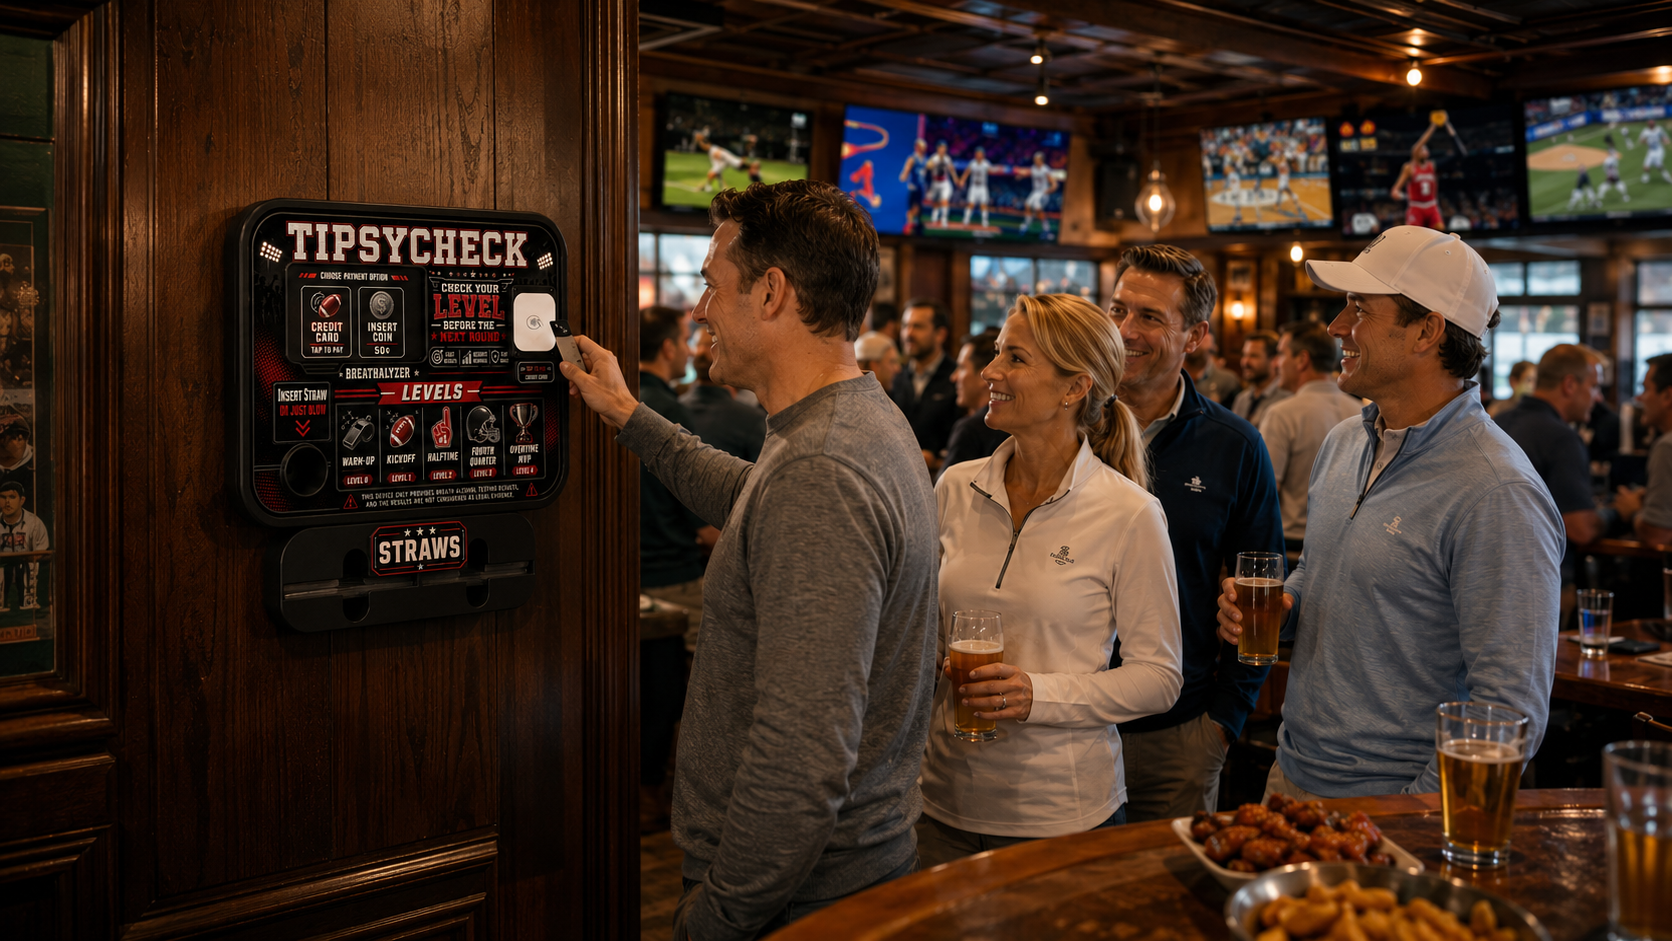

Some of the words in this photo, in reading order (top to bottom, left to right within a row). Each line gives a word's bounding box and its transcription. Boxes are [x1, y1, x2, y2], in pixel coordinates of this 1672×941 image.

[286, 220, 528, 268] TIPSYCHECK
[320, 271, 342, 280] CHOOSE
[441, 283, 473, 293] CHECK
[475, 284, 499, 294] YOUR
[433, 293, 505, 320] LEVEL
[311, 321, 343, 332] CREDIT
[367, 321, 398, 332] INSERT
[443, 320, 476, 330] BEFORE
[478, 320, 495, 330] THE
[315, 332, 339, 342] CARD
[372, 332, 393, 342] COIN
[440, 331, 466, 342] NEXT
[469, 331, 500, 342] ROUND
[311, 346, 323, 354] TAP
[332, 346, 344, 354] PAY
[345, 367, 411, 380] BREATHALYZER
[401, 383, 463, 401] LEVELS
[280, 404, 289, 416] OR
[290, 404, 307, 416] JUST
[308, 404, 327, 415] BLOW
[471, 446, 495, 456] FOURTH
[509, 443, 539, 454] OVERTIME
[342, 455, 376, 467] WARM-UP
[386, 453, 416, 464] KICKOFF
[427, 451, 459, 462] HALFTIME
[469, 456, 497, 467] QUARTER
[517, 454, 532, 464] MVP
[391, 474, 408, 482] LEVEL
[379, 535, 460, 565] STRAWS
